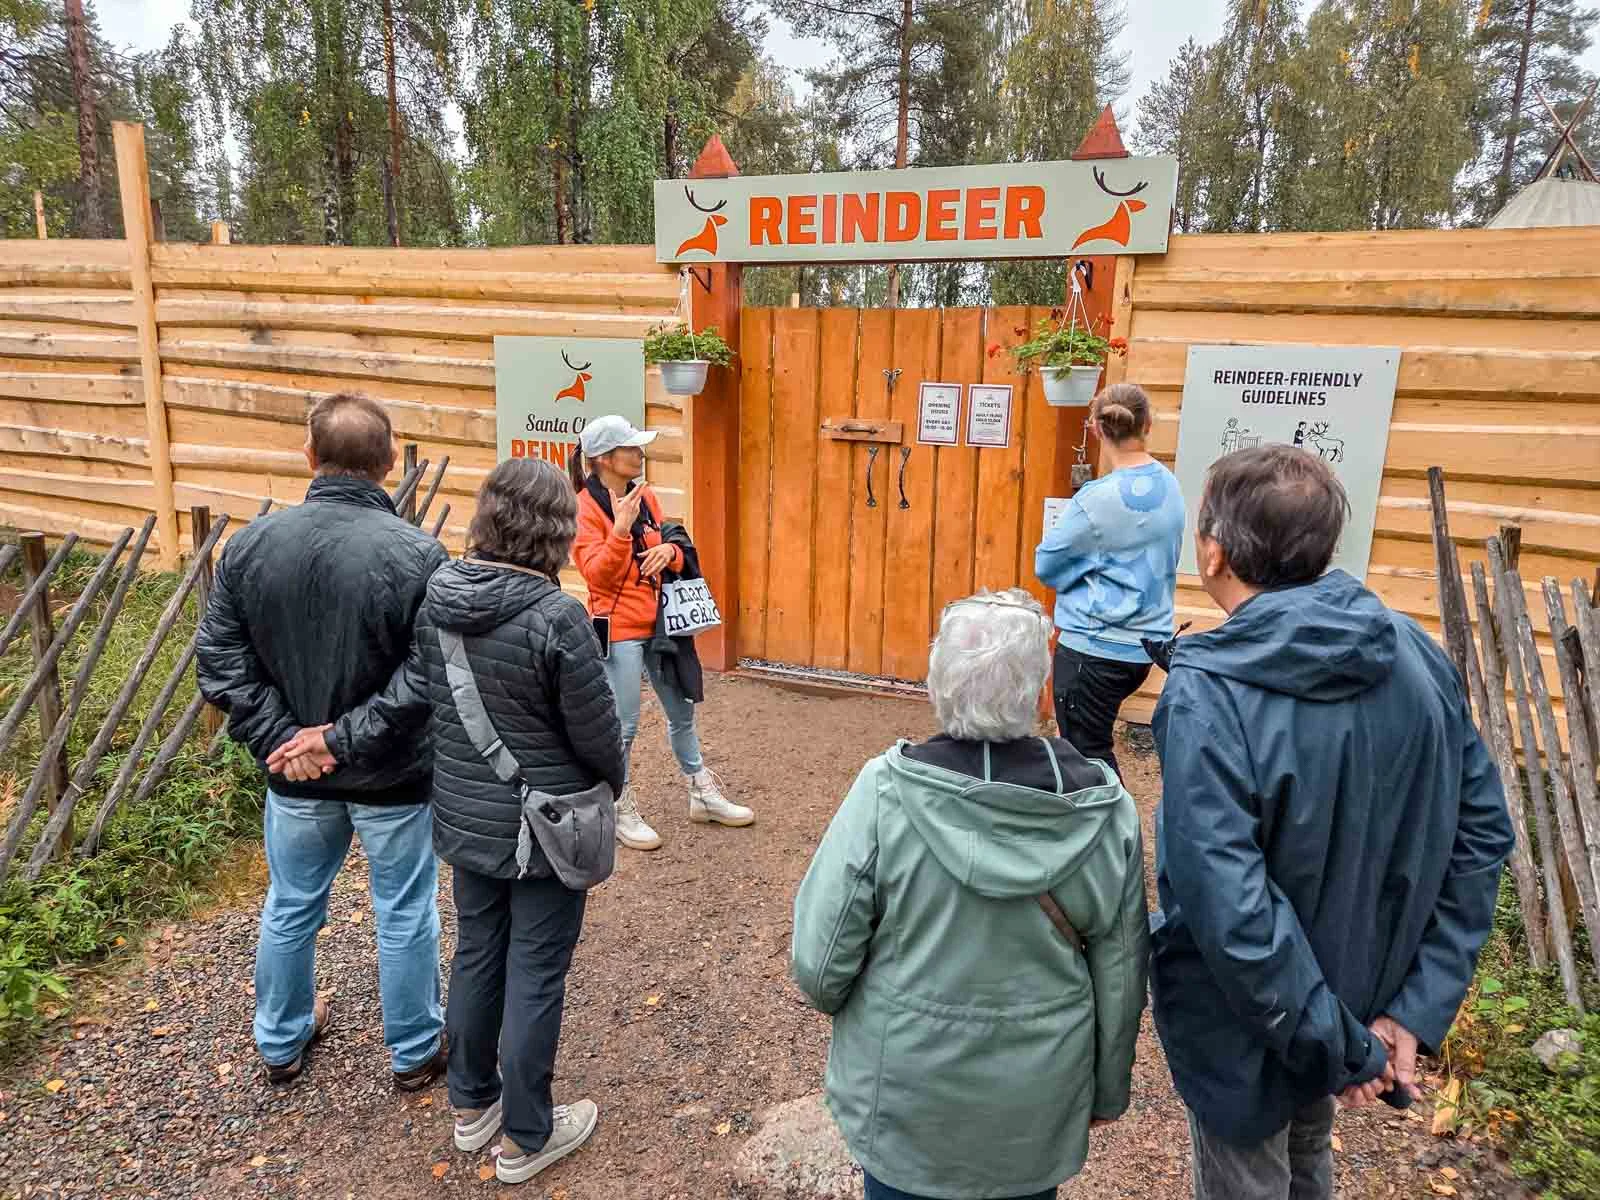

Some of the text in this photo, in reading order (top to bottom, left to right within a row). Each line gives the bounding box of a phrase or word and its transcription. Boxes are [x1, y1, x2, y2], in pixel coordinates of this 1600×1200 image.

[749, 185, 1047, 246] REINDEER
[1213, 370, 1363, 388] REINDEER-FRIENDLY
[1241, 389, 1327, 406] GUIDELINES
[525, 413, 586, 434] Santa Cl
